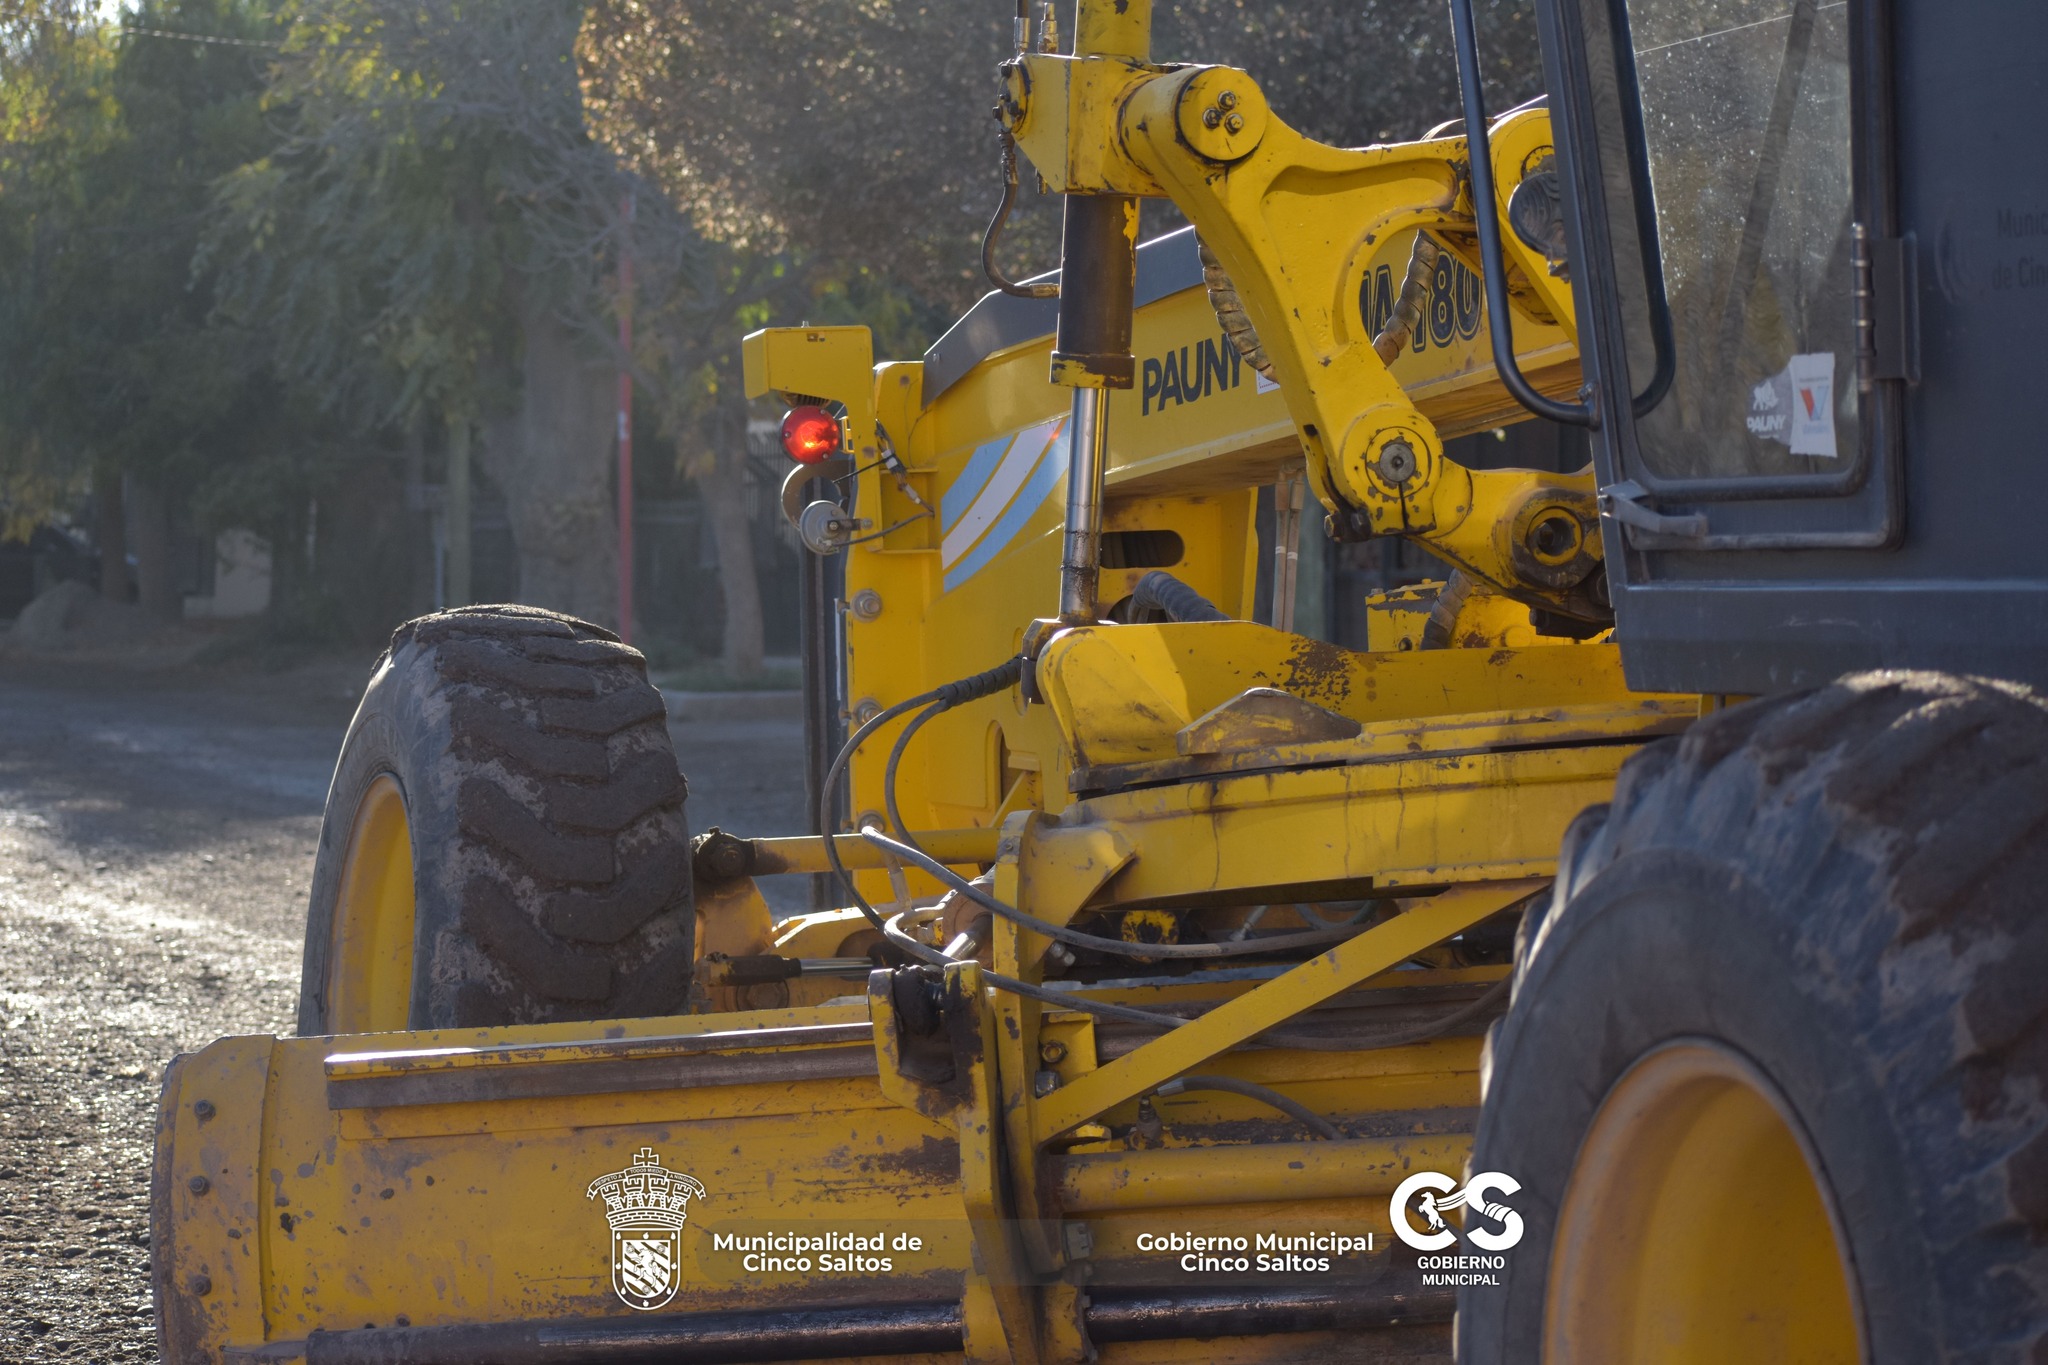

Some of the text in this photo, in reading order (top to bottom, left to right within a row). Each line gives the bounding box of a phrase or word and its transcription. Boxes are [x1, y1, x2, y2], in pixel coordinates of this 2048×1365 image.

[1992, 255, 2048, 290] de Cin
[1142, 332, 1241, 417] PAUNY
